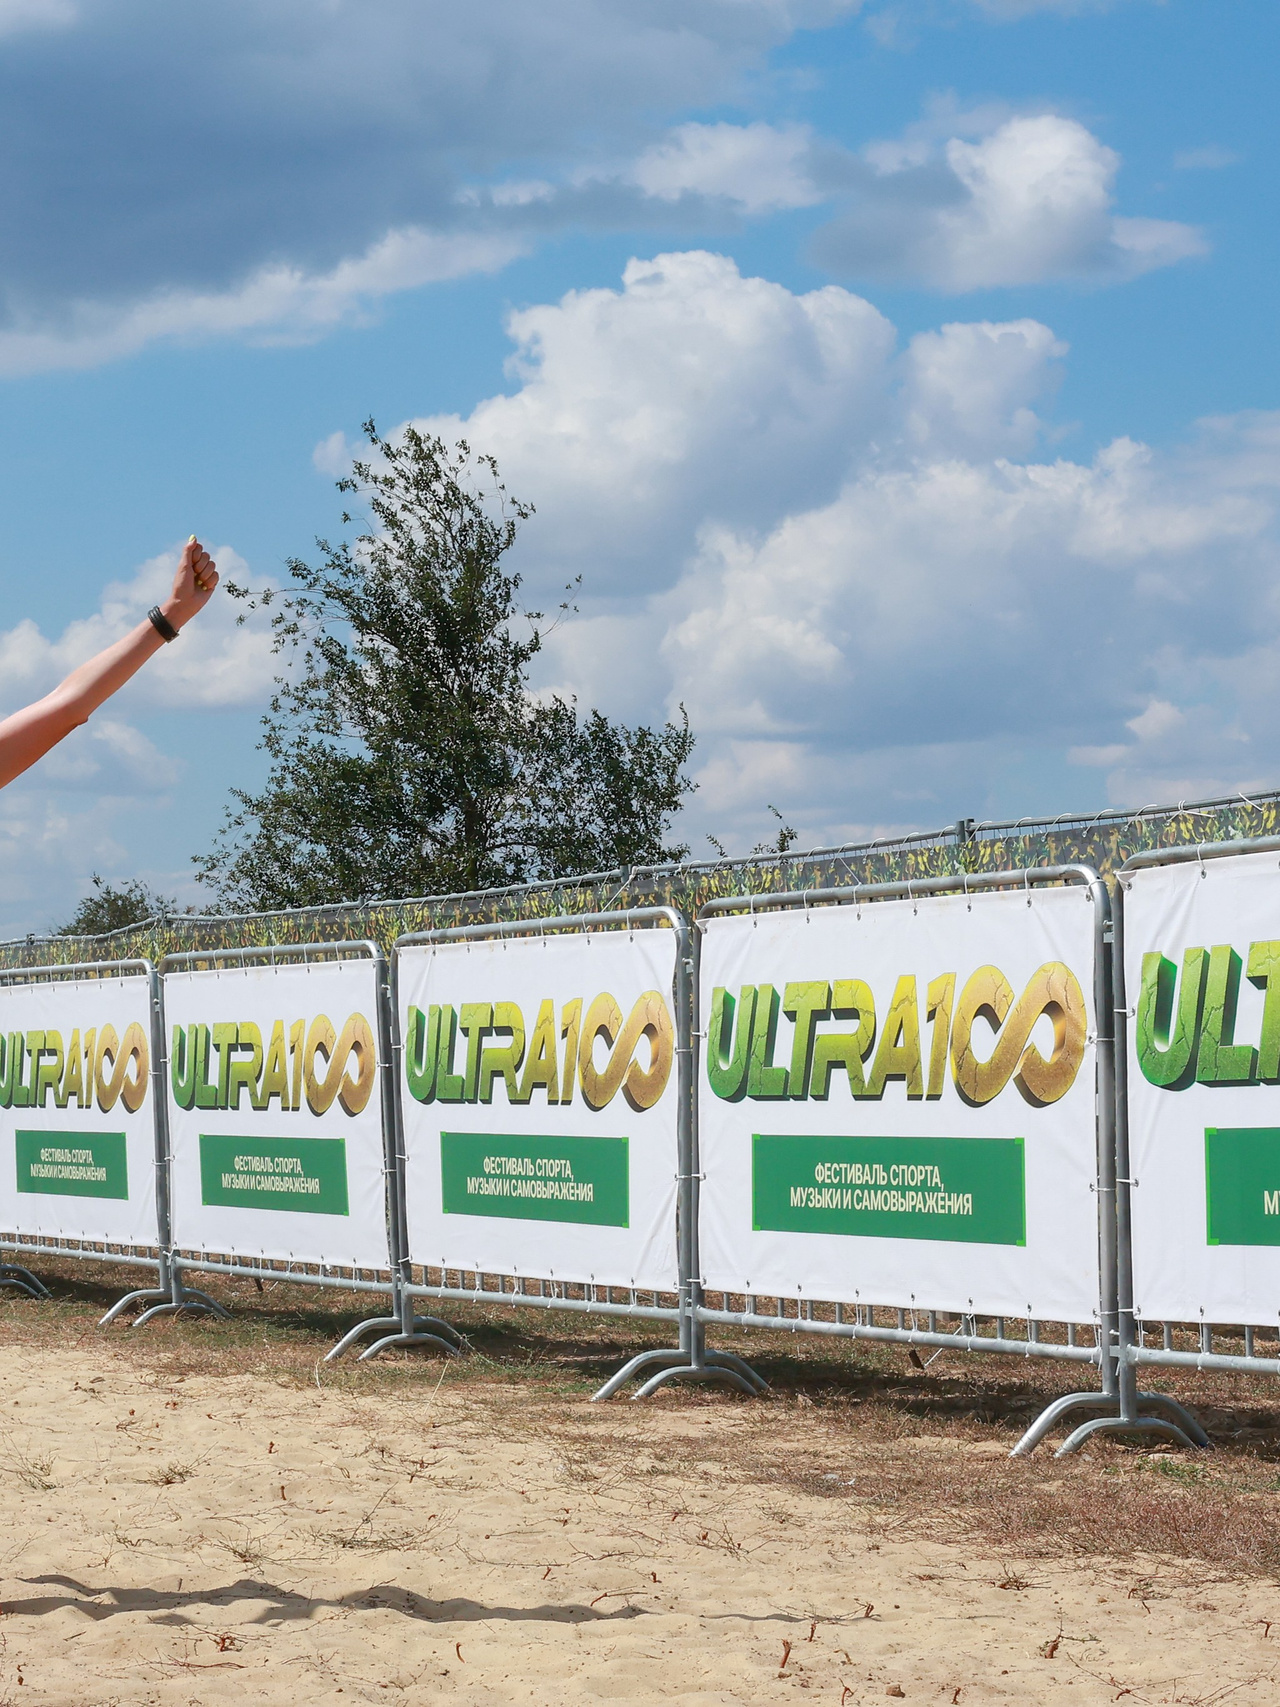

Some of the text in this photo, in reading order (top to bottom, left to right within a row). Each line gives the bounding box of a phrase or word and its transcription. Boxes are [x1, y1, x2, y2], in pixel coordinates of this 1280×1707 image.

[706, 960, 1088, 1109] ULTRA100
[405, 990, 674, 1113] ULTRA100
[172, 1012, 376, 1118] ULTRA100
[40, 1148, 94, 1167] ФЕСТИВАЛЬ СПОРТА,
[234, 1155, 304, 1177] ФЕСТИВАЛЬ СПОРТА,
[483, 1156, 574, 1182] ФЕСТИВАЛЬ СПОРТА,
[30, 1163, 54, 1178] МУЗЫКИ
[58, 1165, 107, 1181] САМОВЫРАЖЕНИЯ
[221, 1173, 320, 1194] МУЗЫКИ И САМОВЫРАЖЕНИЯ
[814, 1162, 945, 1192] ФЕСТИВАЛЬ СПОРТА,
[467, 1176, 594, 1202] МУЗЫКИ И САМОВЫРАЖЕНИЯ
[790, 1186, 973, 1215] МУЗЫКИ И САМОВЫРАЖЕНИЯ
